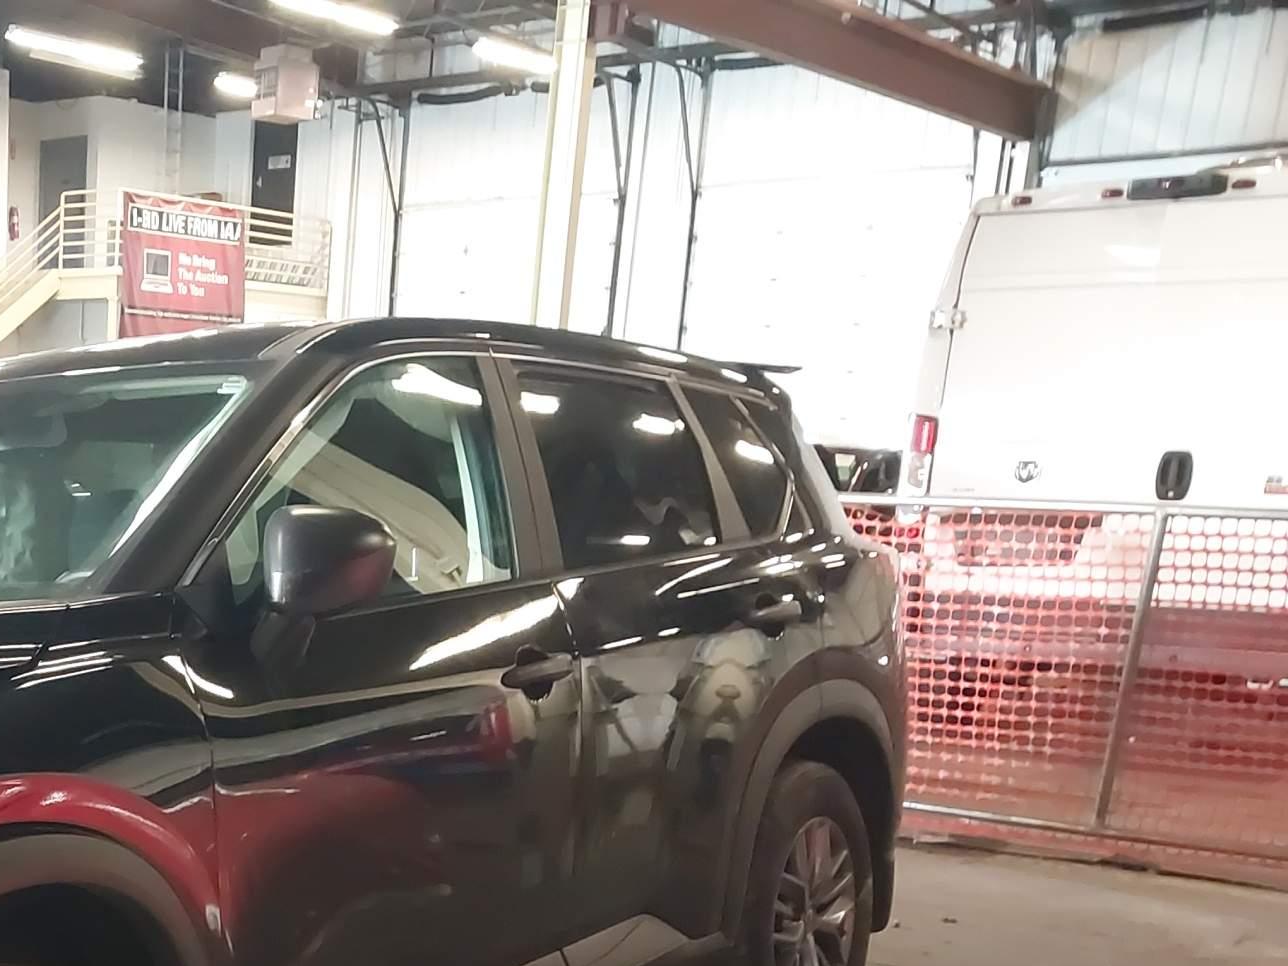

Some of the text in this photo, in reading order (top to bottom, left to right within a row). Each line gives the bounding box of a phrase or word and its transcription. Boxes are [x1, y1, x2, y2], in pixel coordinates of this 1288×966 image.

[161, 212, 185, 234] LIVE
[187, 216, 218, 239] FROM
[177, 267, 229, 285] The Auction
[177, 282, 188, 295] To
